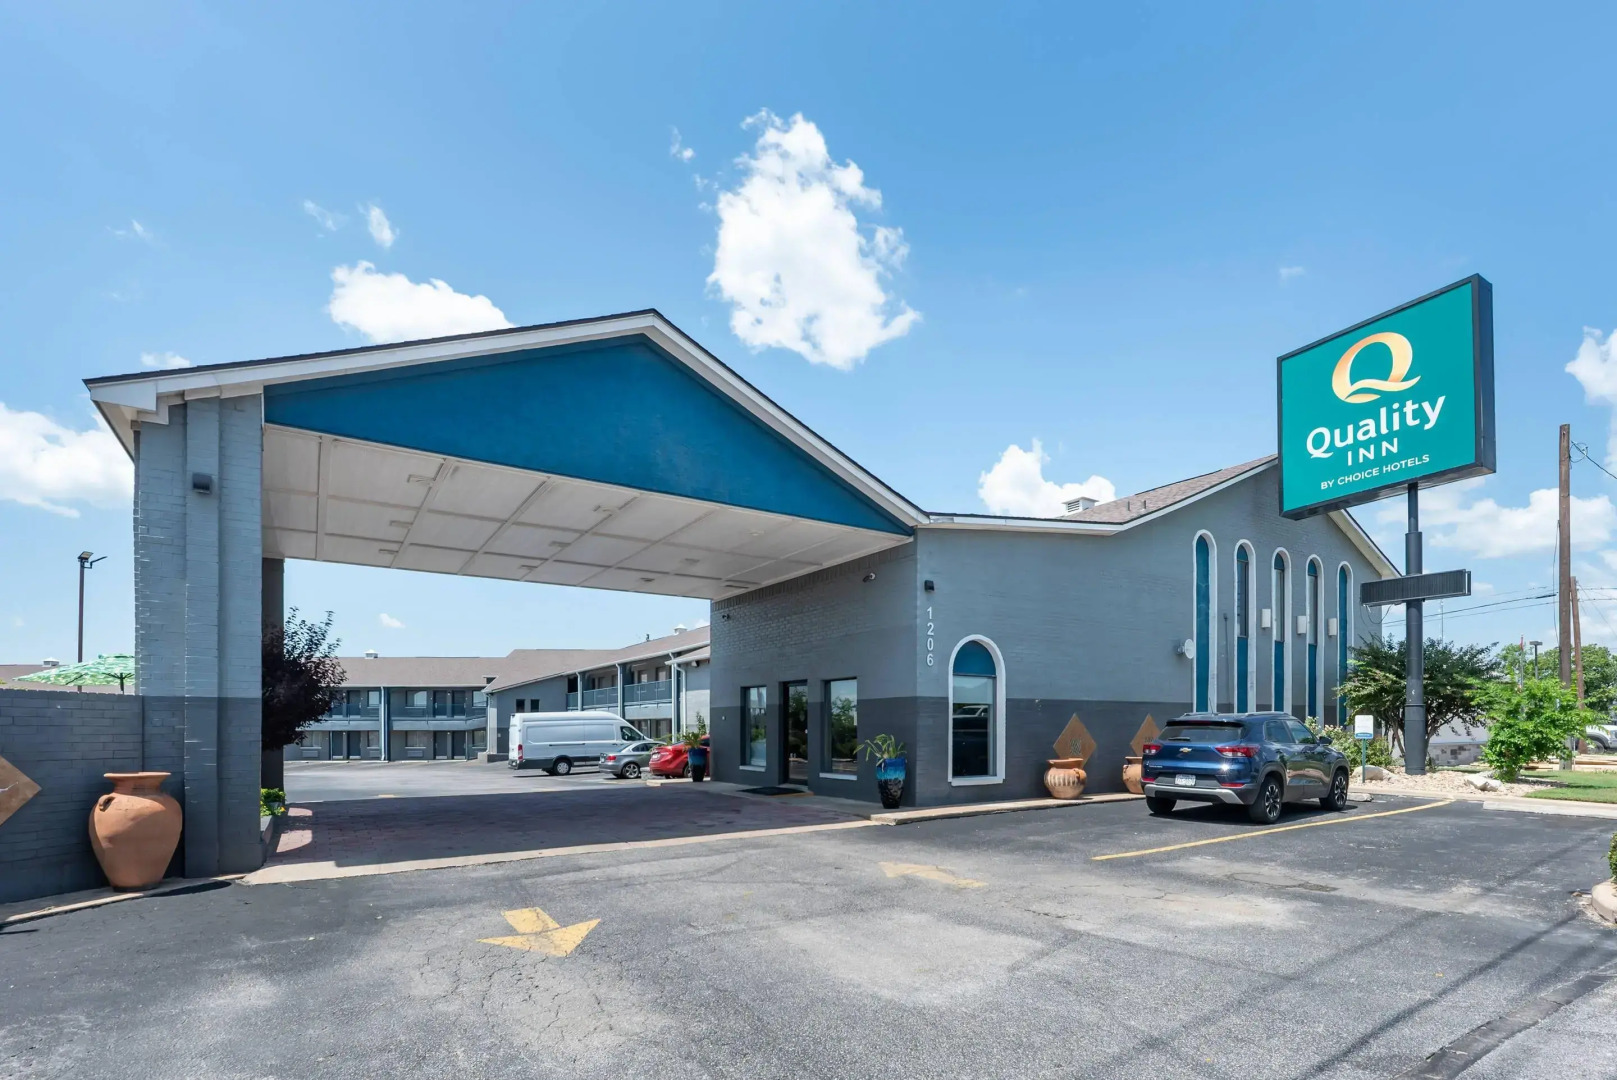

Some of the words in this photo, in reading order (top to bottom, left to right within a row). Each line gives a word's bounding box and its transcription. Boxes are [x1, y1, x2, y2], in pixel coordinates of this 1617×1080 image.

[1331, 331, 1421, 403] Q
[1306, 395, 1446, 459] Quality
[1347, 437, 1398, 466] INN
[1320, 479, 1335, 490] BY
[1337, 467, 1380, 485] CHOICE
[1382, 454, 1430, 474] HOTELS
[926, 606, 934, 666] 1206
